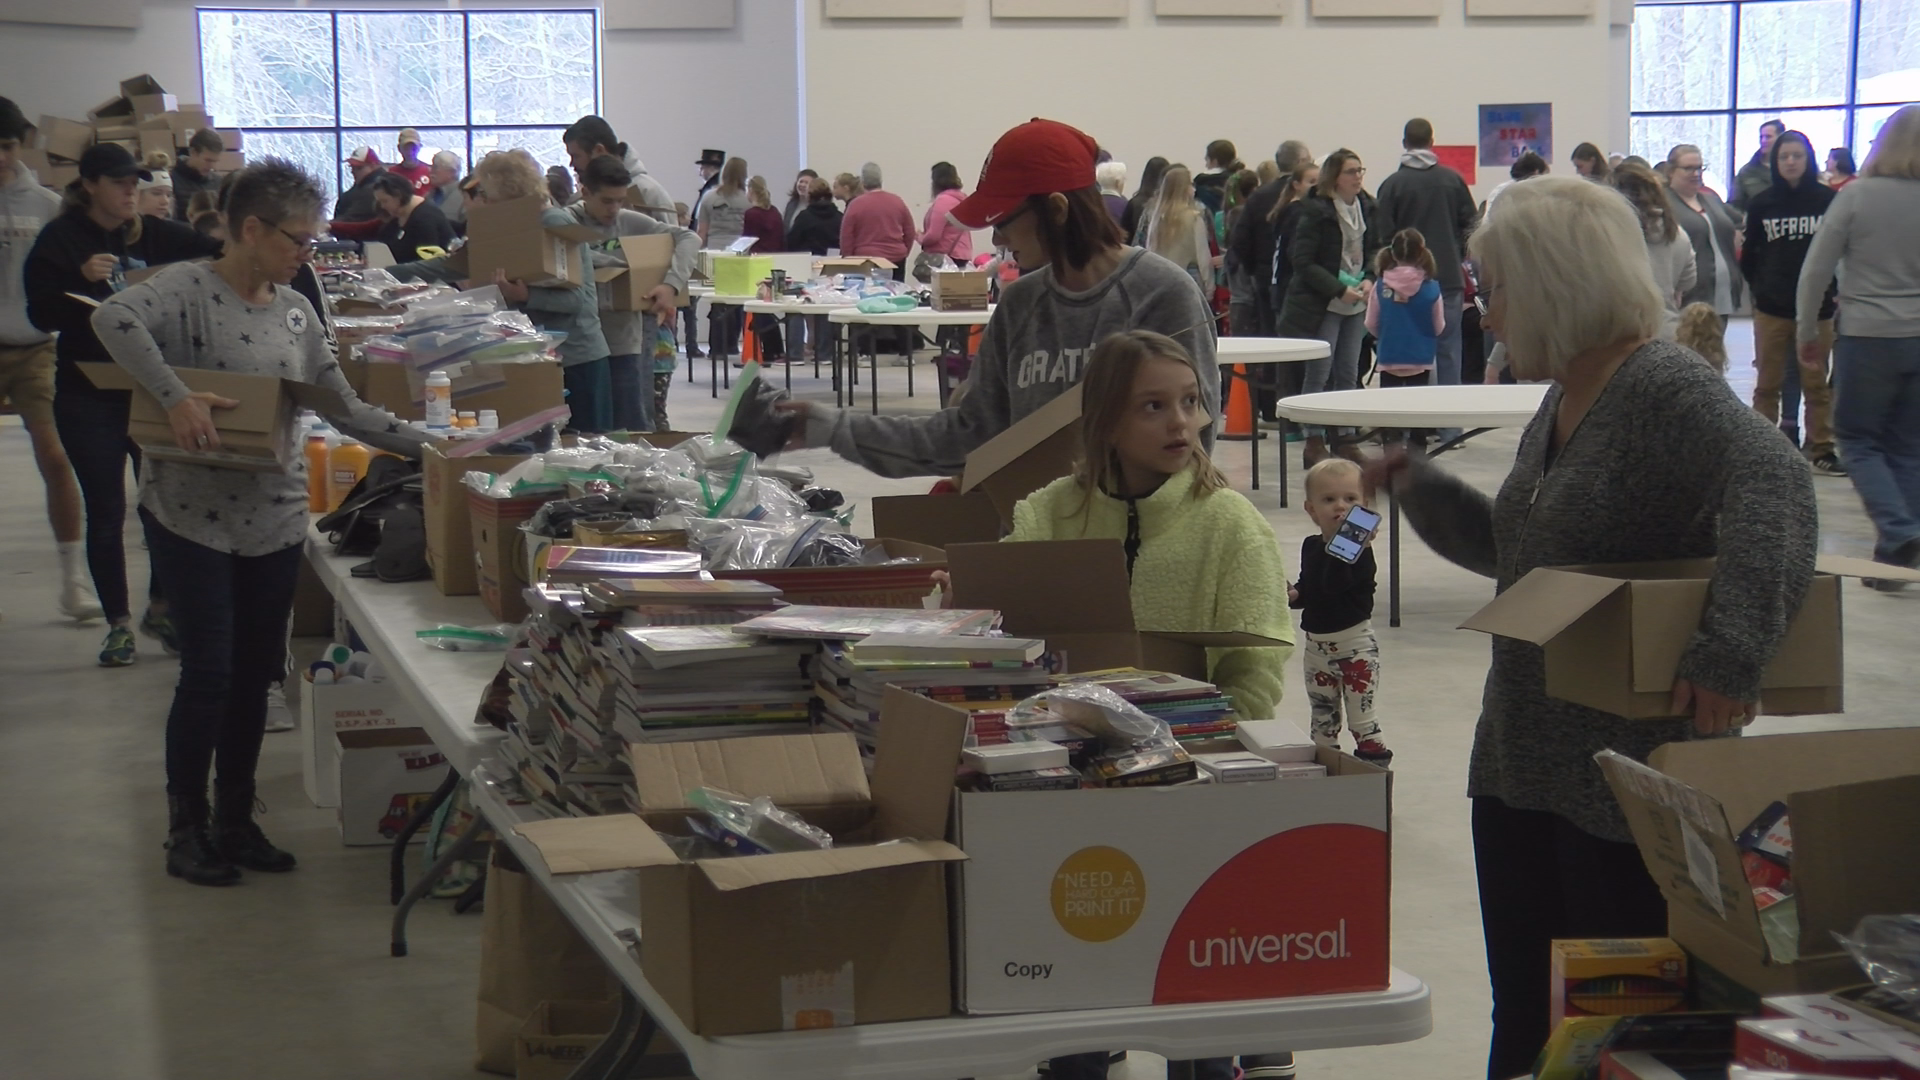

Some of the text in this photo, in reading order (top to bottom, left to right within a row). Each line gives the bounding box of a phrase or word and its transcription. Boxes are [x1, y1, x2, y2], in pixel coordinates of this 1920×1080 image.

[1500, 128, 1536, 139] STAR
[335, 710, 367, 718] SERIAL
[1122, 870, 1135, 886] A
[1065, 888, 1098, 899] HARD
[1065, 899, 1114, 918] PRINT
[1004, 961, 1053, 980] Copy
